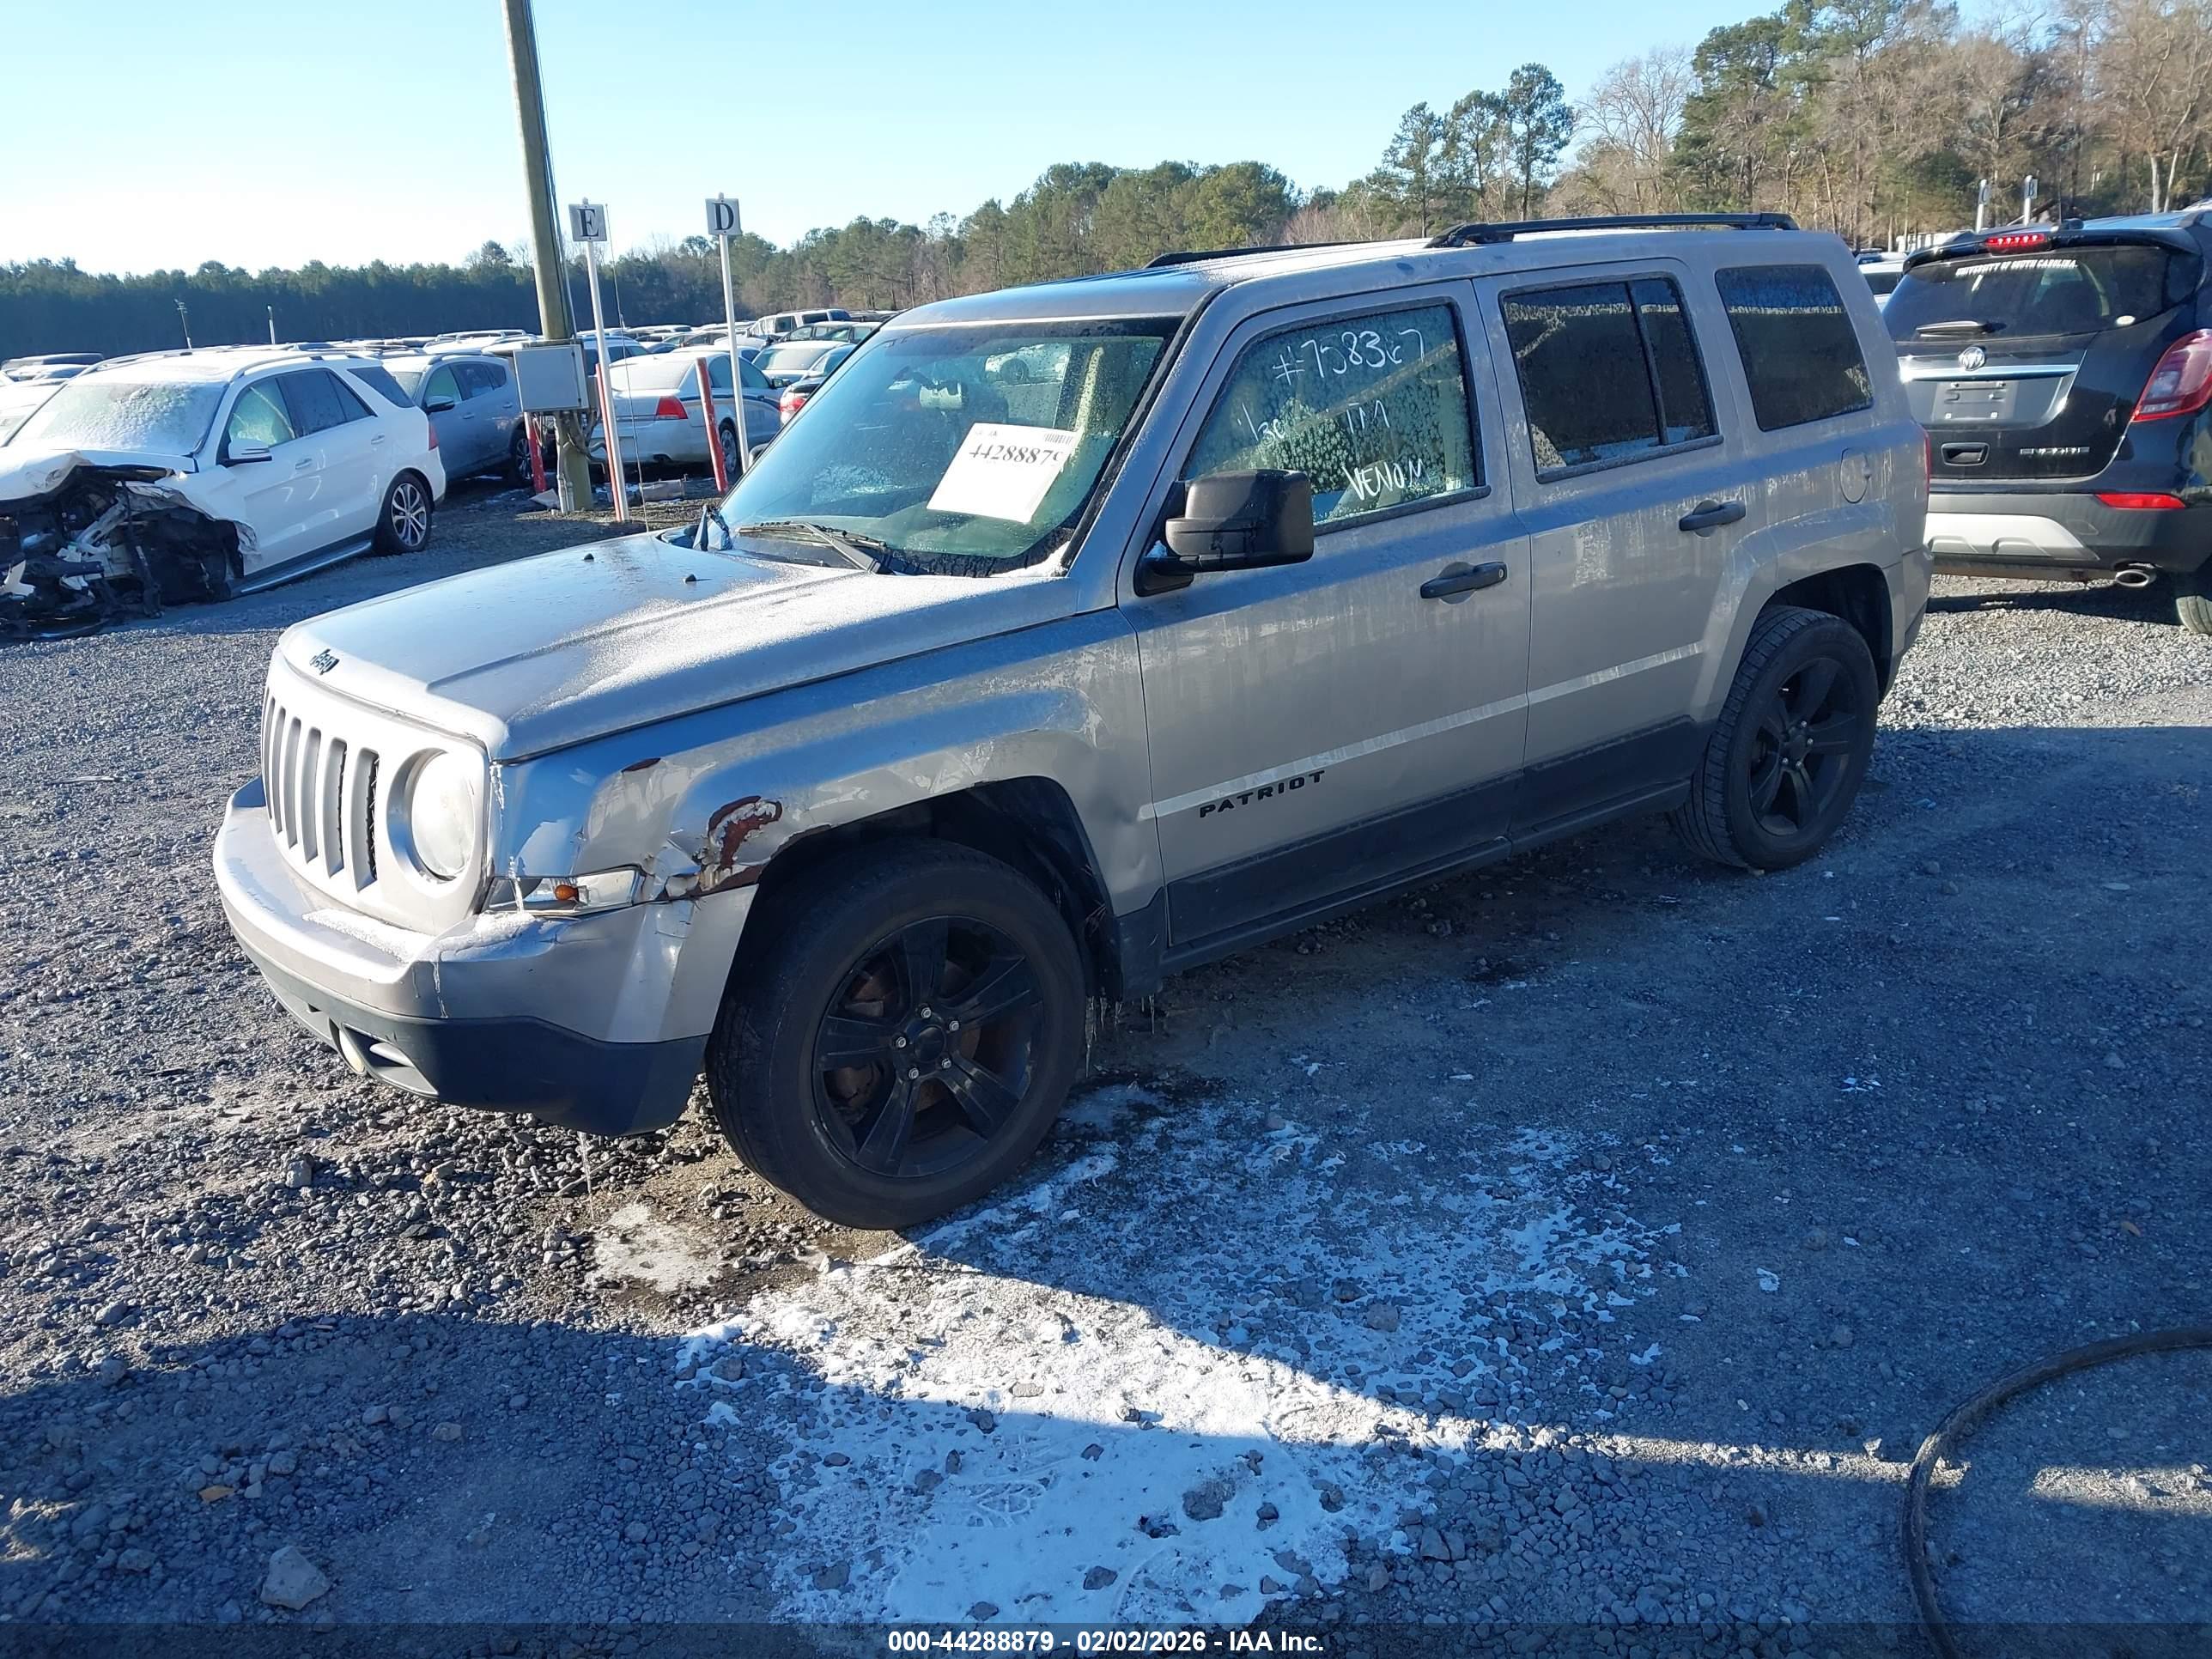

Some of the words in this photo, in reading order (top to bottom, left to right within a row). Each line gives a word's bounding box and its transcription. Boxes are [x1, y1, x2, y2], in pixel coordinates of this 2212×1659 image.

[576, 208, 599, 238] E
[714, 202, 735, 231] D
[1955, 262, 2002, 276] UNIVERSITY
[2010, 259, 2038, 270] SOUTH
[1341, 458, 1431, 501] VENOM
[1199, 770, 1325, 818] PATRIOT
